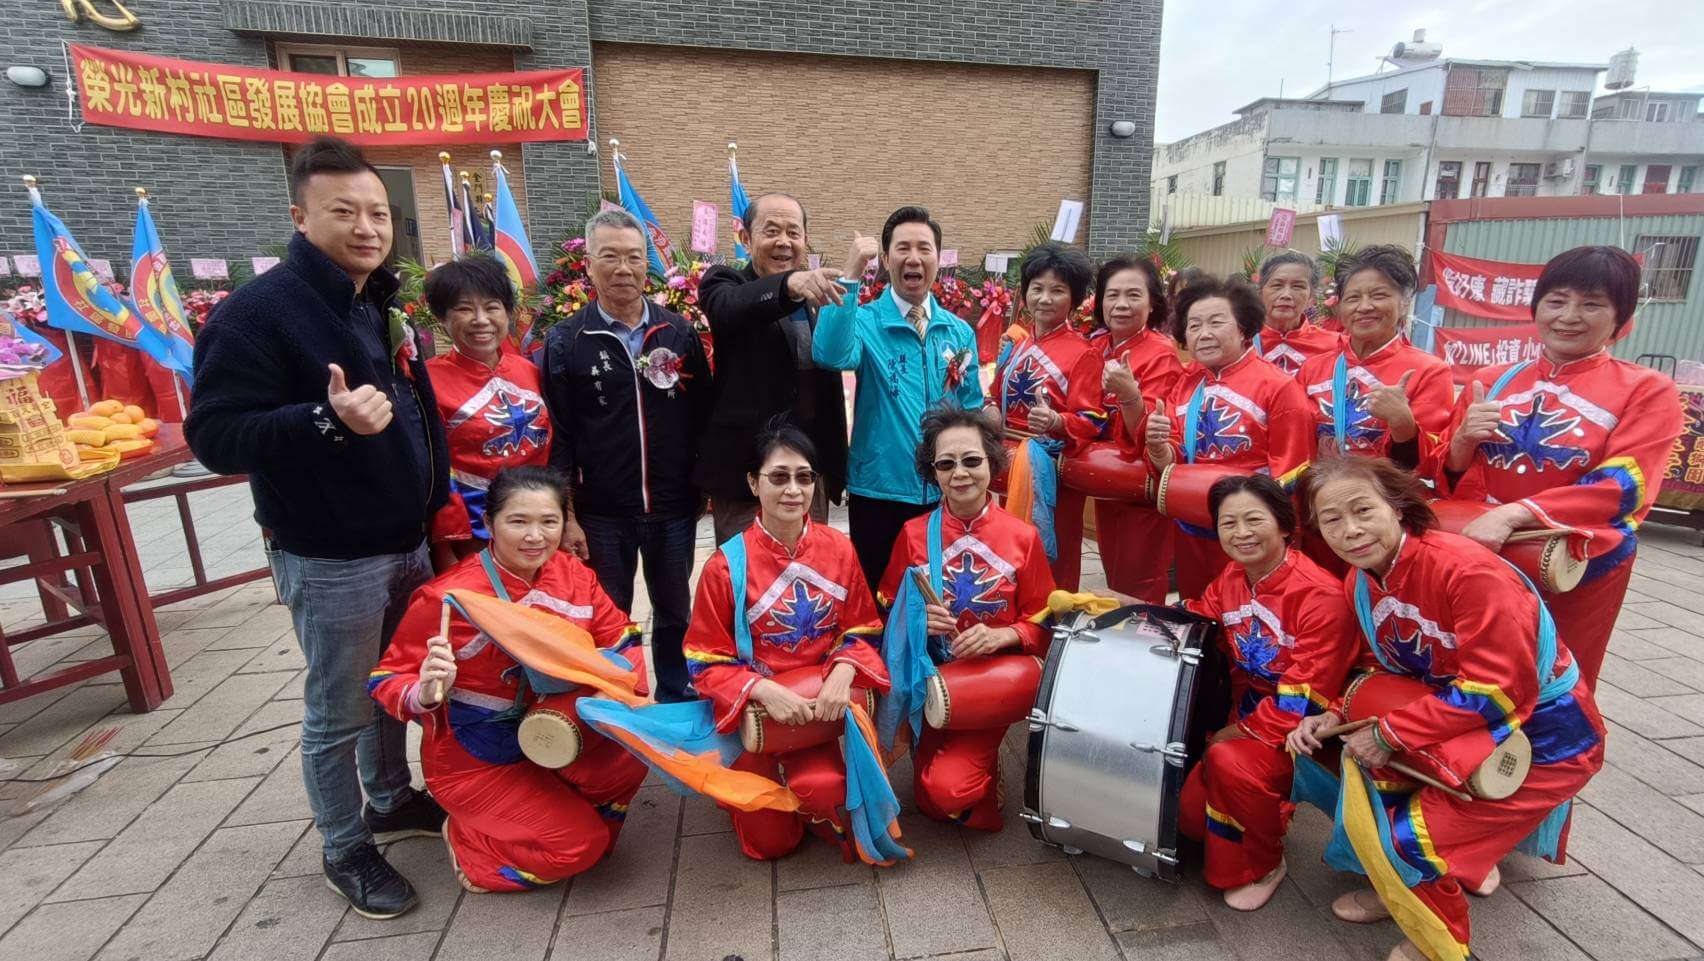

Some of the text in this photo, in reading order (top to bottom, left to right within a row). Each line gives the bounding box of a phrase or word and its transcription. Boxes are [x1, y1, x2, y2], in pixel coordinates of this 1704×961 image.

[80, 57, 583, 134] 榮光新村社區發展協會成立20週年慶祝大會
